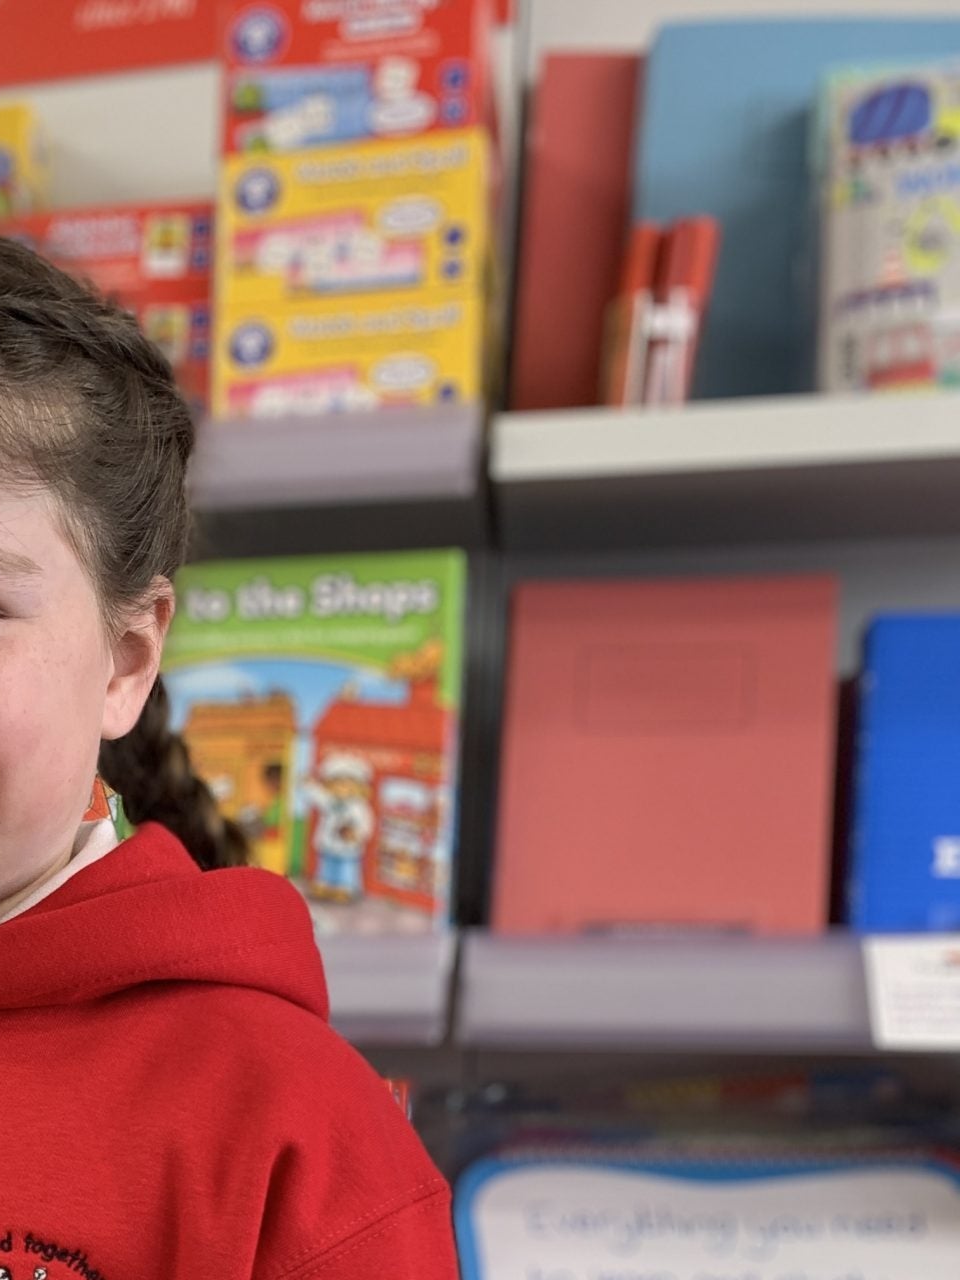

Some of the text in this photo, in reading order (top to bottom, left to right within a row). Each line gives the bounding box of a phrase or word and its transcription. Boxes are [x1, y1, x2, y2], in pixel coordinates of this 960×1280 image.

[185, 570, 438, 623] to the Shops
